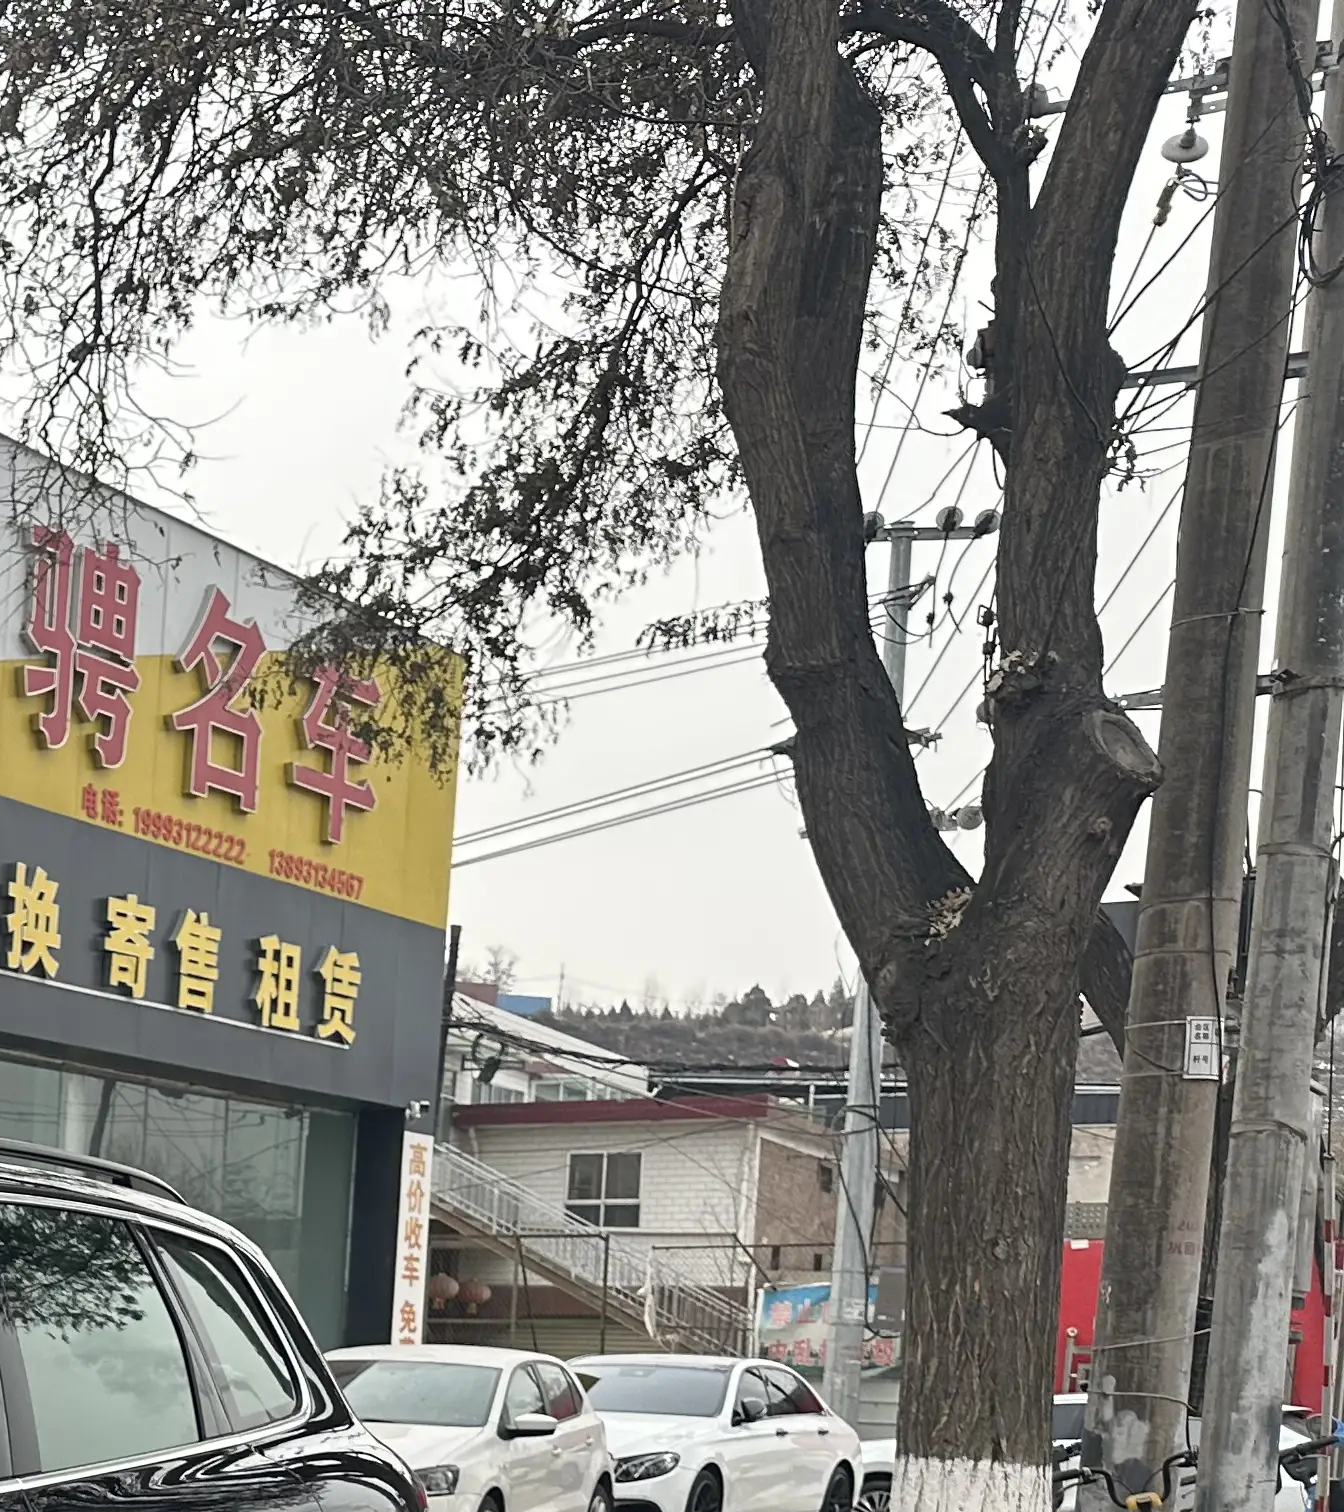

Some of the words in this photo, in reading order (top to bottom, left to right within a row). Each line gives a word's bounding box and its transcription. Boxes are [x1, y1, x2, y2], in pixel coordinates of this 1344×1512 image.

[132, 806, 247, 865] 19993122222
[268, 849, 364, 900] 13893134567
[103, 893, 222, 1013] 寄售
[254, 934, 361, 1044] 租赁
[402, 1142, 428, 1287] 高价收车
[399, 1300, 417, 1345] 免
